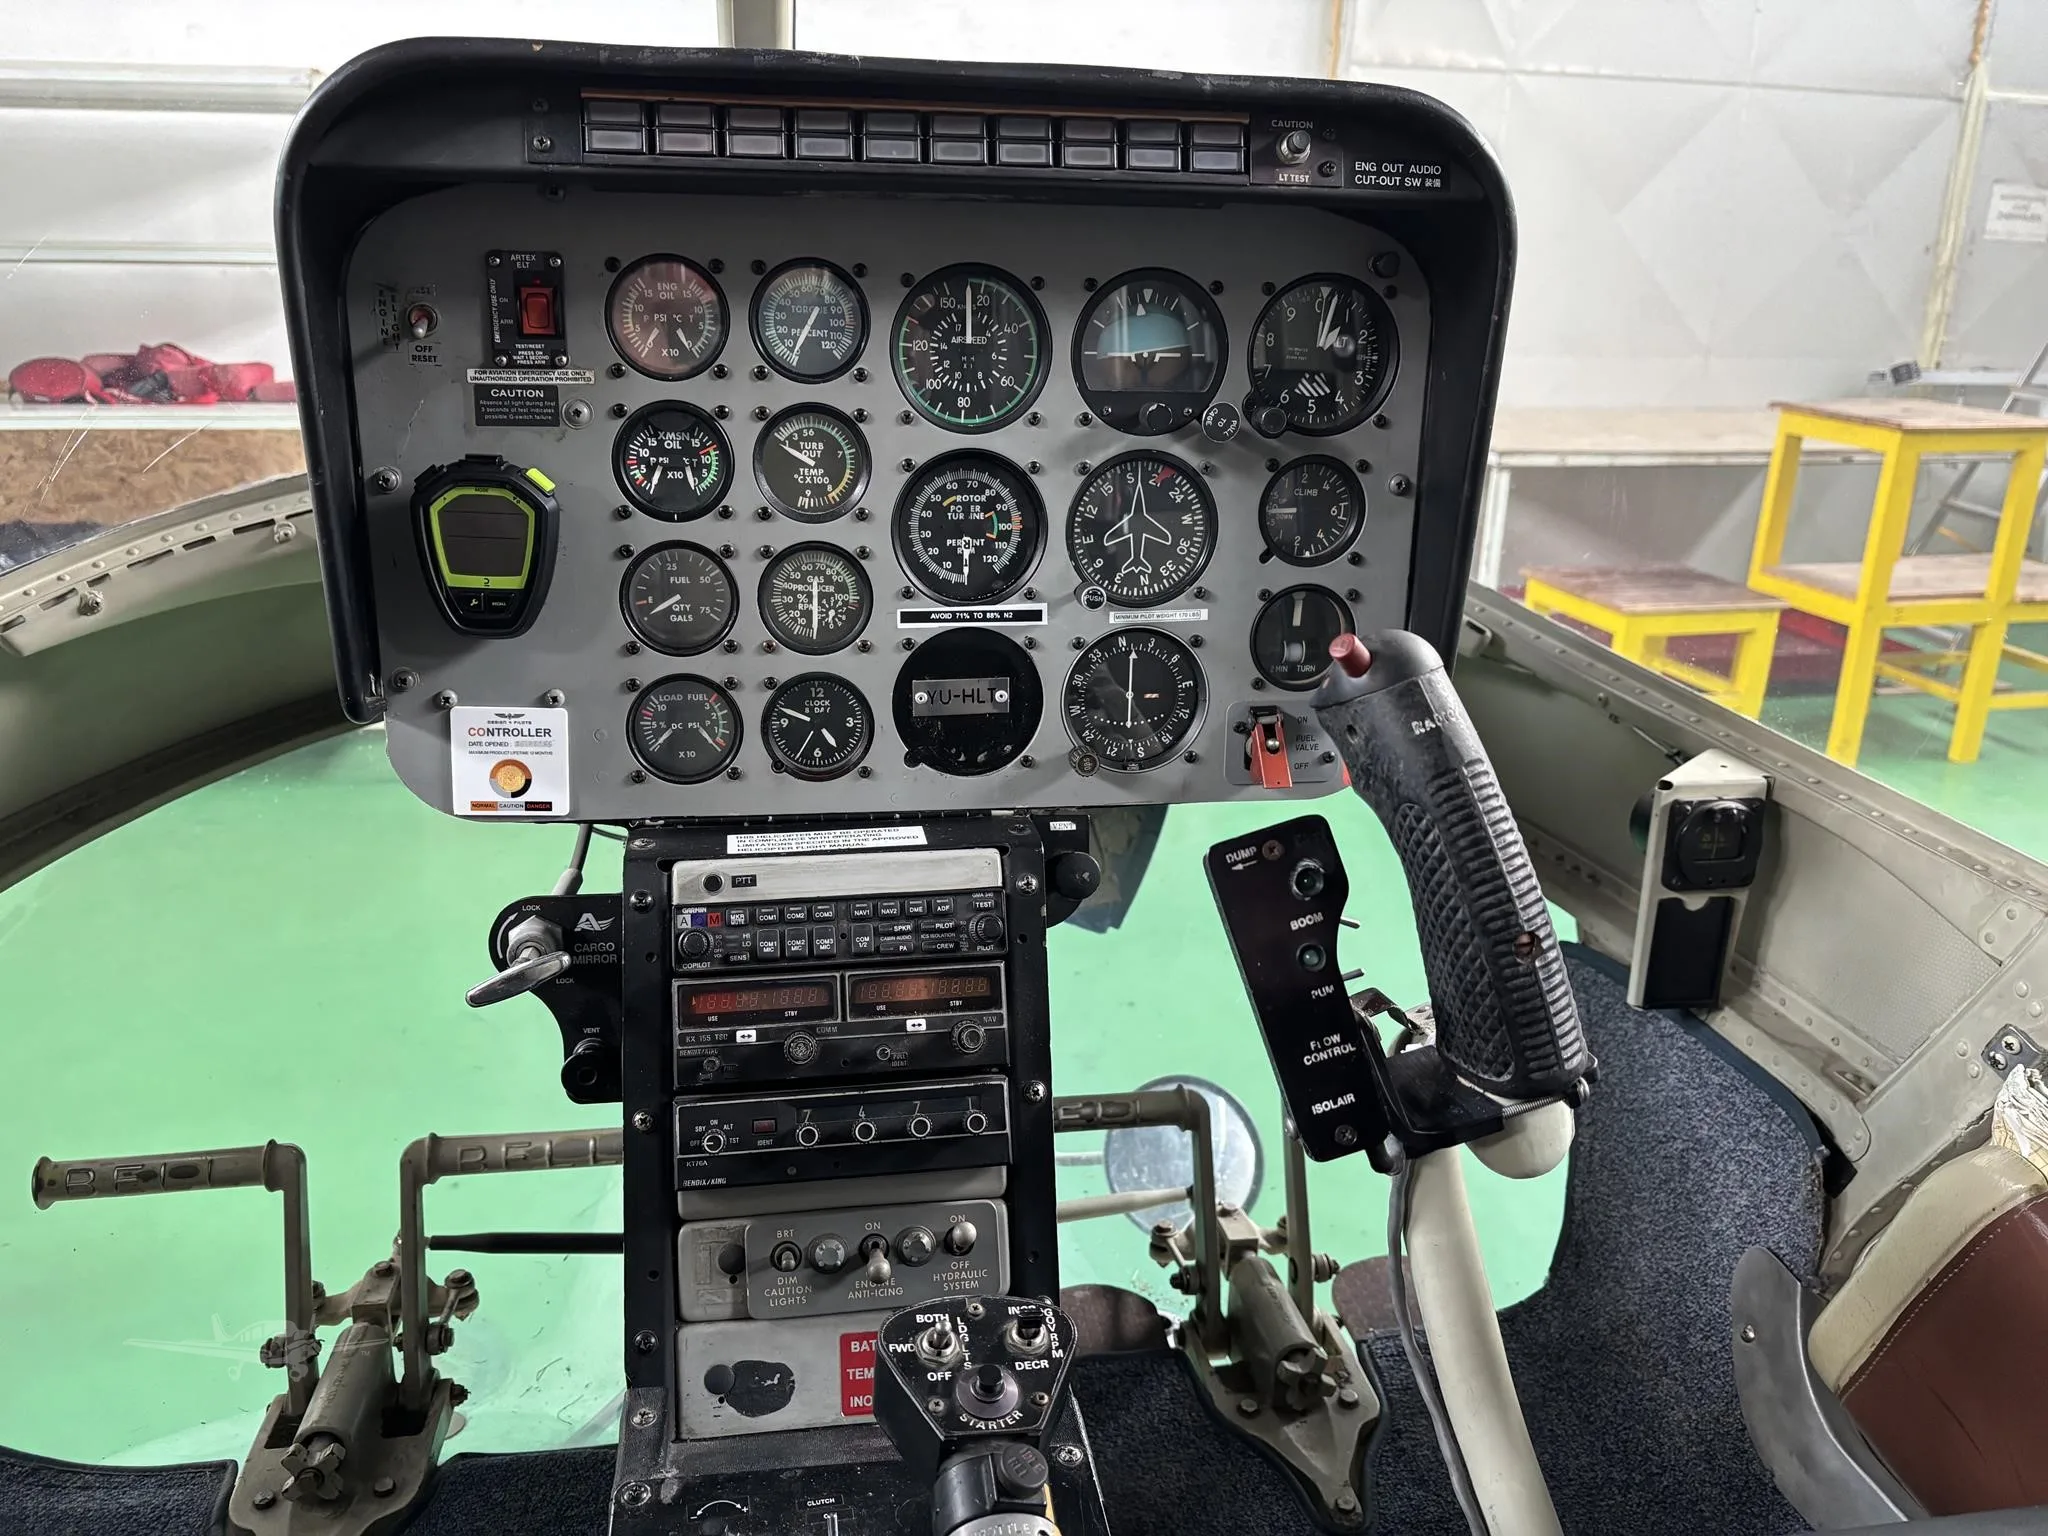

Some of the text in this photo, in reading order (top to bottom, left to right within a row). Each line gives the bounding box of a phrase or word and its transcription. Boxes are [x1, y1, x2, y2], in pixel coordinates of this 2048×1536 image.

[1272, 120, 1313, 129] CAUTION
[1355, 162, 1441, 175] ENG OUT AUDIO
[1290, 174, 1309, 182] TEST
[1355, 176, 1421, 186] CUT-OUT SW
[657, 282, 678, 291] ENG
[659, 291, 675, 300] OIL
[940, 298, 955, 308] 150
[977, 295, 989, 306] 20
[654, 314, 667, 323] PSI
[1004, 323, 1018, 334] 40
[913, 340, 928, 350] 120
[412, 354, 438, 362] RESET
[926, 379, 941, 390] 100
[1001, 376, 1014, 387] 60
[491, 389, 544, 398] CAUTION
[958, 397, 970, 407] 80
[1206, 408, 1237, 436] PULL TO CAGE
[658, 431, 690, 440] XMSN
[664, 441, 682, 449] OIL
[800, 442, 824, 450] TURB
[802, 450, 821, 458] OUT
[667, 471, 684, 479] X10
[1168, 488, 1184, 503] 24
[947, 512, 984, 520] TURINE
[666, 563, 677, 571] 25
[672, 604, 691, 612] QTY
[670, 614, 693, 622] GALS
[810, 688, 824, 698] 12
[927, 688, 996, 705] YU-HLT
[659, 694, 683, 702] LOAD
[468, 728, 552, 737] CONTROLLER
[1226, 846, 1257, 864] DUMP
[680, 917, 688, 926] A
[1290, 912, 1323, 930] BOOM
[574, 943, 615, 952] CARGO
[573, 954, 617, 964] MIRROR
[1303, 1043, 1356, 1066] CONTROL
[1311, 1093, 1355, 1114] ISOLAIR
[683, 1178, 726, 1186] BENDIX/KING
[950, 1215, 965, 1223] ON
[865, 1222, 880, 1230] ON
[777, 1230, 794, 1238] BRT
[951, 1261, 969, 1269] OFF
[777, 1276, 798, 1285] DIM
[933, 1270, 988, 1282] HYDRAULIC
[856, 1278, 895, 1288] ENGNE
[943, 1280, 979, 1290] SYSTEM
[764, 1285, 812, 1296] CAUTION
[848, 1287, 903, 1299] ANTI-ICING
[769, 1296, 807, 1306] LIGHTS
[916, 1314, 949, 1323] BOTH
[957, 1317, 969, 1342] LDG
[889, 1344, 915, 1352] FWD
[963, 1343, 972, 1370] LTS
[1015, 1360, 1049, 1370] DECR
[927, 1371, 952, 1381] OFF
[960, 1410, 1023, 1429] STARTER
[806, 1498, 835, 1507] CLUTCH
